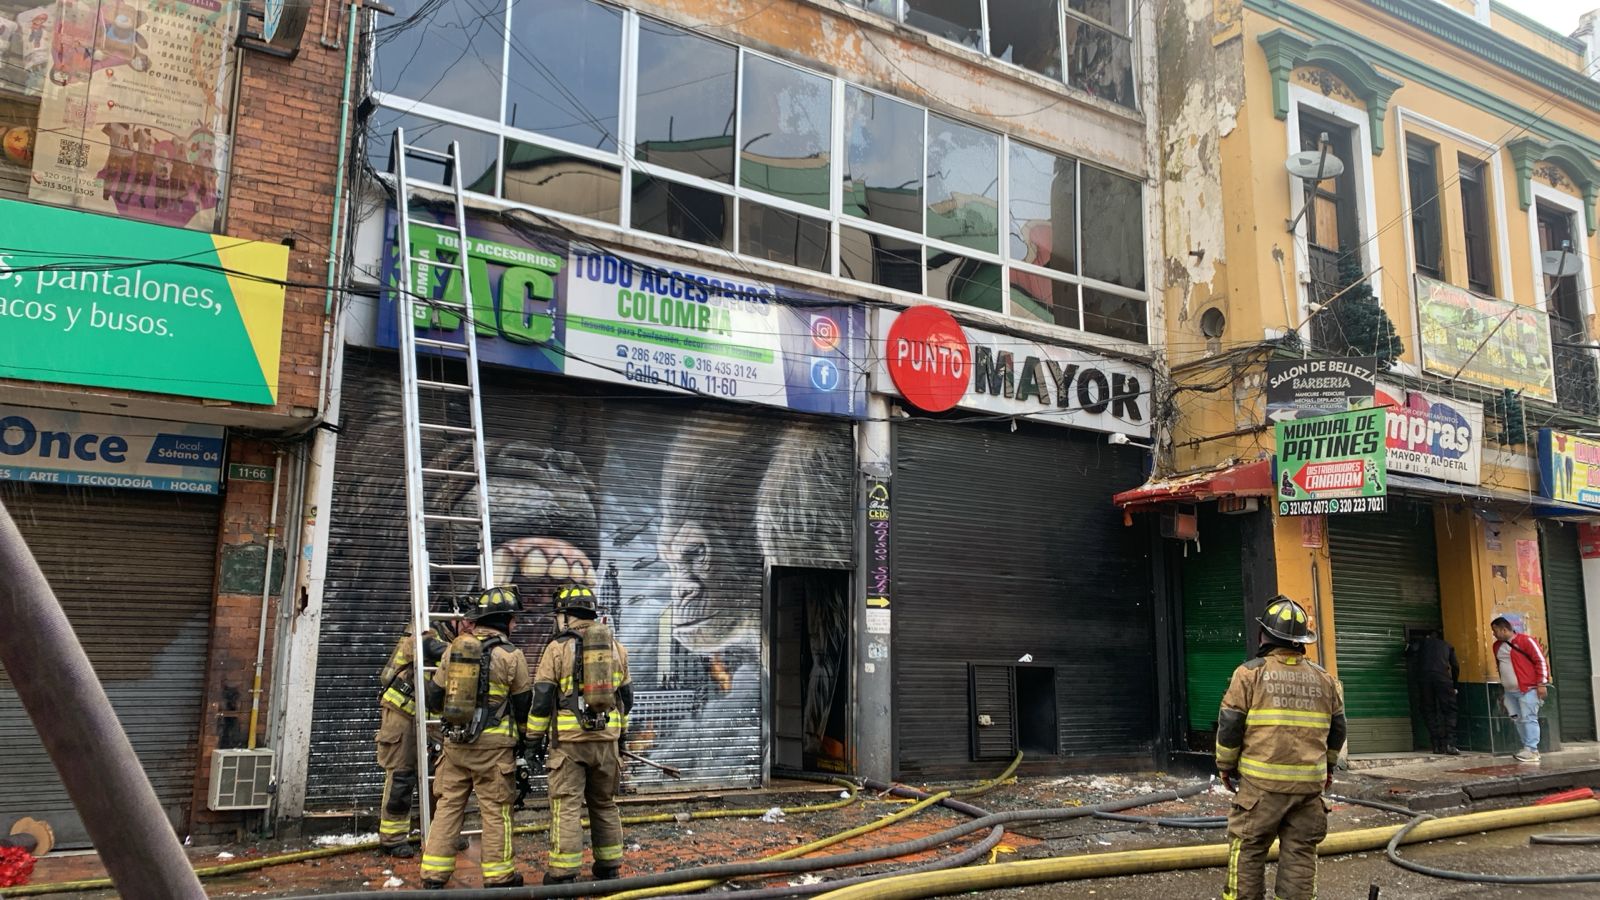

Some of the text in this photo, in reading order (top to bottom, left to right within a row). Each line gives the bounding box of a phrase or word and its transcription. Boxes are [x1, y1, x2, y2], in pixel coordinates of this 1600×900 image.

[475, 242, 558, 269] ACCESORIOS
[573, 248, 634, 288] TODO
[36, 265, 223, 316] pantalones,
[414, 249, 430, 319] COOMBA
[64, 306, 82, 332] y
[90, 302, 174, 337] busos.
[617, 289, 733, 337] COLOMBIA
[631, 346, 650, 361] 286
[652, 350, 677, 367] 4285
[695, 357, 712, 373] 316
[714, 361, 732, 376] 435
[897, 338, 964, 380] PUNTO
[625, 361, 660, 386] Calle
[664, 368, 677, 387] 11
[704, 375, 738, 397] 11-60
[974, 344, 1143, 422] MAYOR
[1270, 360, 1376, 389] SALON DE BELLEZA
[0, 415, 129, 464] Once
[1283, 414, 1378, 441] MUNDIAL DE
[158, 447, 218, 462] Sótano 04
[175, 440, 204, 451] Local:
[1282, 431, 1380, 463] PATINES
[238, 467, 267, 479] 11-66
[1306, 461, 1361, 476] DISTRIBUIDORES
[1390, 449, 1468, 472] MAYOR Y AL DETAL
[28, 471, 60, 483] ARTE
[77, 473, 154, 489] TECNOLOGÍA
[170, 481, 212, 493] HOGAR
[1305, 472, 1363, 491] CANARIAM
[1313, 500, 1329, 514] 6073
[1339, 499, 1353, 513] 320
[1353, 498, 1367, 512] 223
[1367, 496, 1384, 512] 7021
[1266, 683, 1323, 698] OFICIALES
